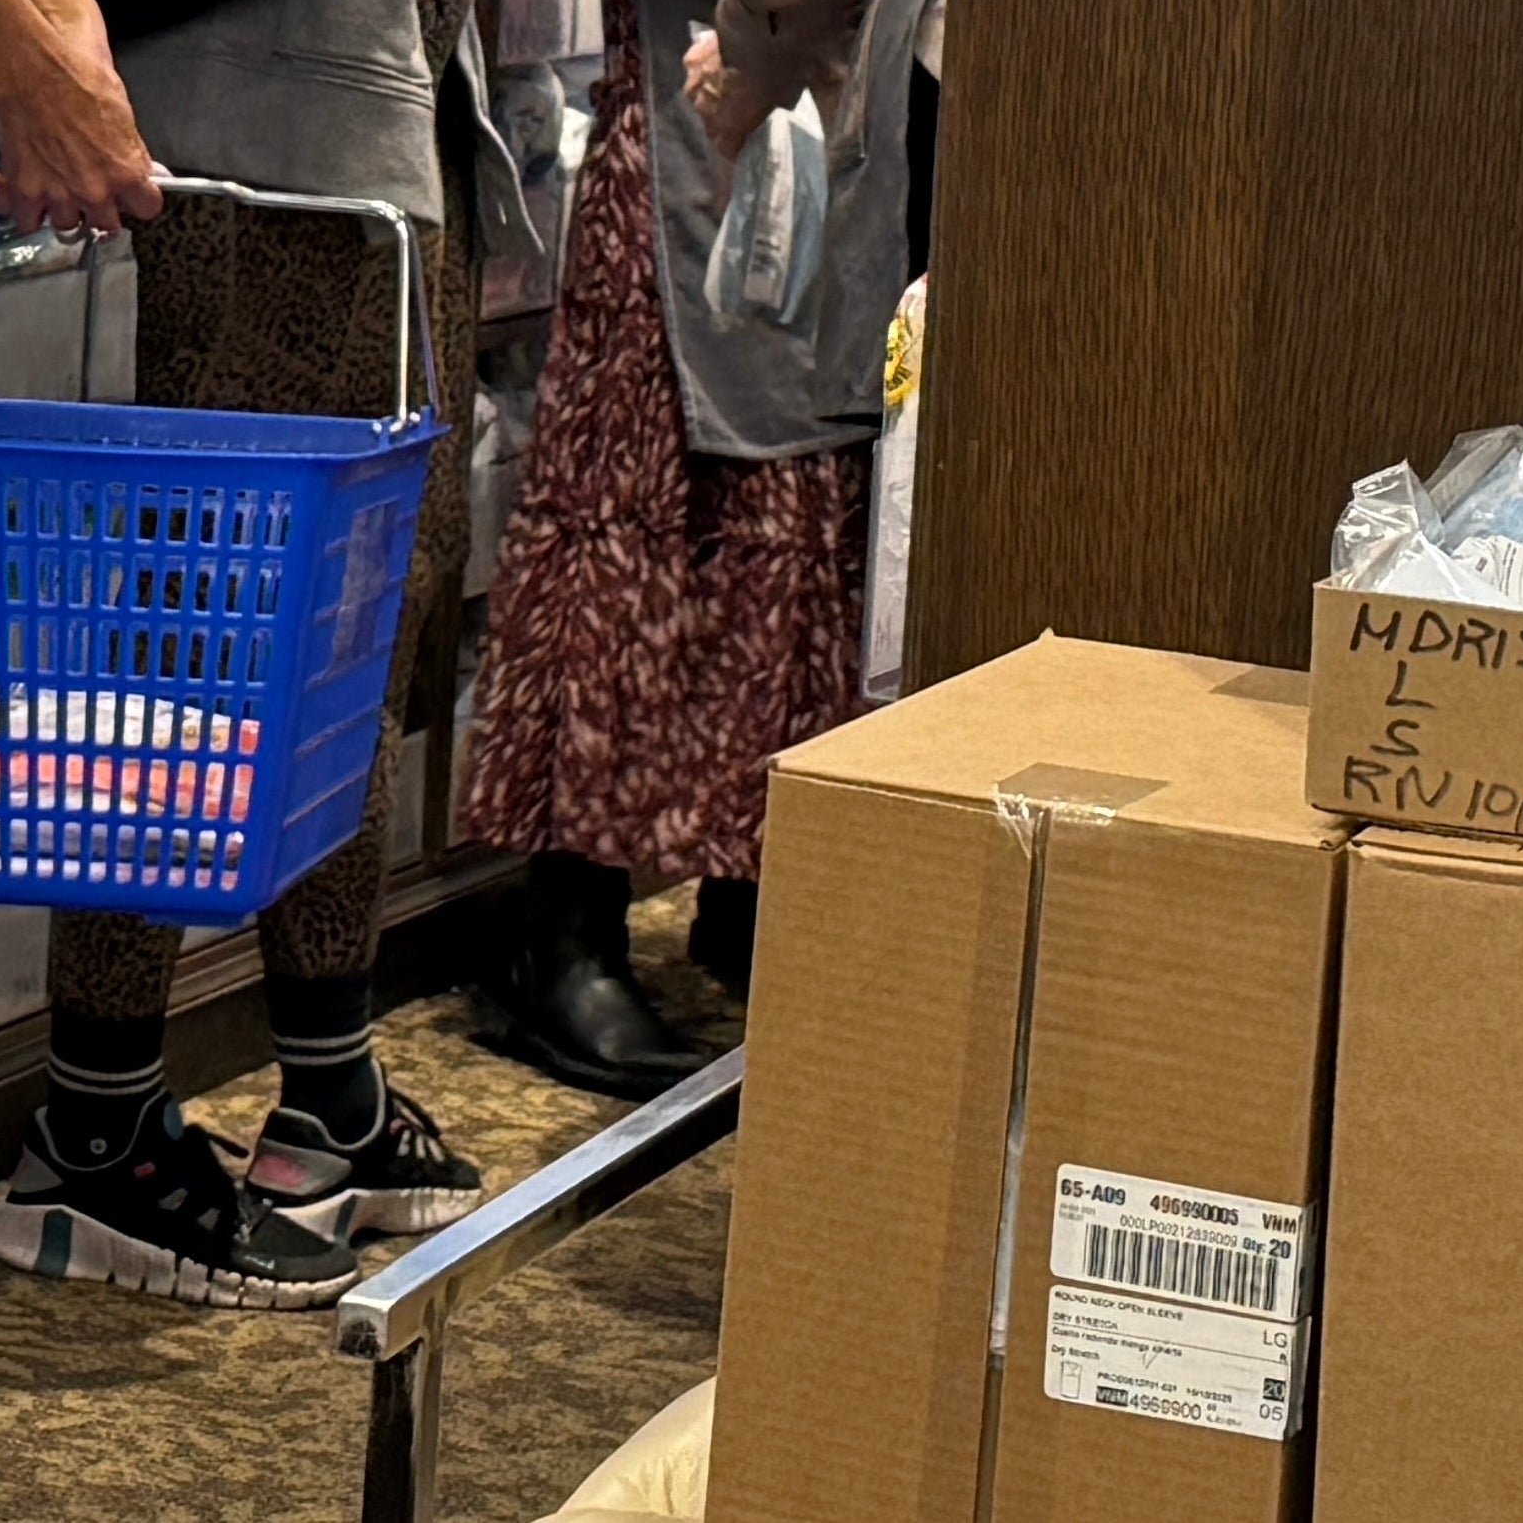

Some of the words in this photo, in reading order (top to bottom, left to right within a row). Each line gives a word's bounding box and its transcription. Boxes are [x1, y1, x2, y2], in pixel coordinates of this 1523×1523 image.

[1384, 659, 1437, 710] L
[1370, 719, 1421, 757] S
[1343, 755, 1453, 811] RN
[1060, 1178, 1126, 1206] 65-A09
[1262, 1212, 1297, 1235] VNM
[1268, 1238, 1291, 1260] 20
[1054, 1290, 1088, 1305] ROUND
[1090, 1297, 1116, 1309] NECK
[1117, 1301, 1145, 1314] OPEN
[1052, 1311, 1073, 1323] DRY
[1262, 1328, 1289, 1349] LG
[1259, 1403, 1284, 1422] 05
